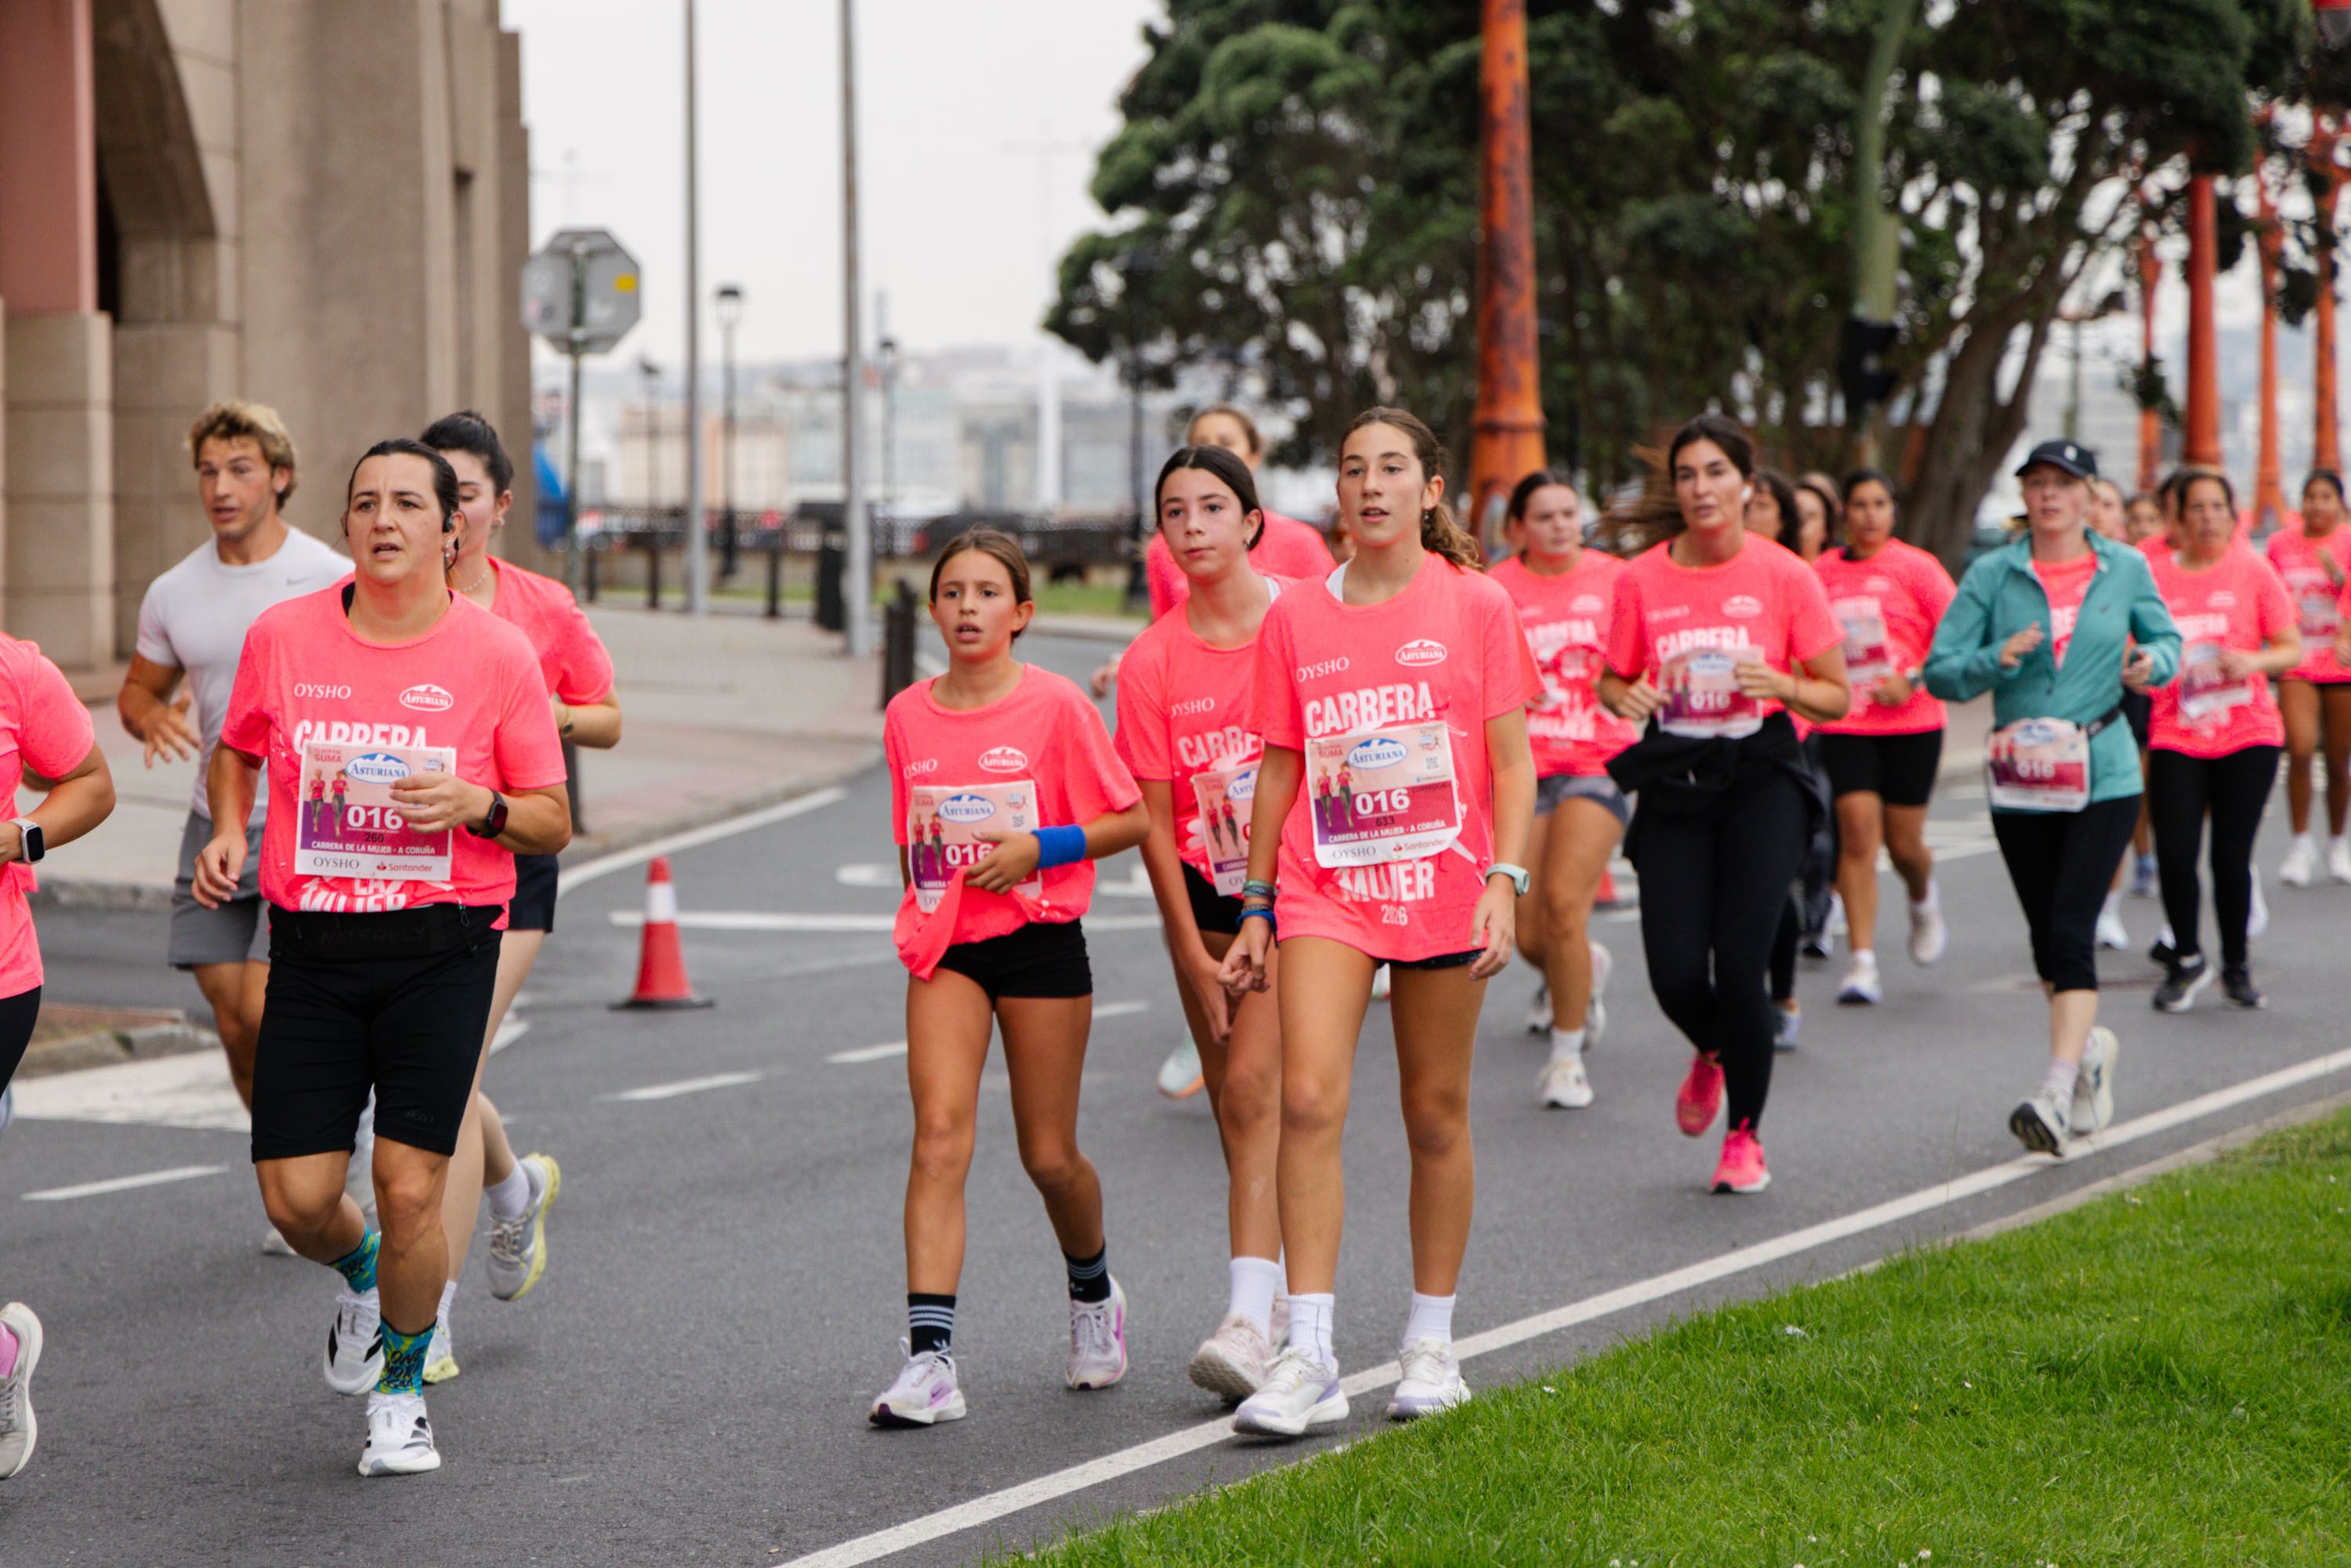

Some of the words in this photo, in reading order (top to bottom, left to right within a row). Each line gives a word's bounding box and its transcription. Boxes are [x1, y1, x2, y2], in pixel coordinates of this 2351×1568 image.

[1400, 650, 1444, 661] ASTURIANA
[1296, 657, 1349, 683] OYSHO
[294, 683, 352, 700] OYSHO
[404, 693, 448, 706] ASTURIANA
[1305, 681, 1436, 737] CARRERA
[314, 754, 342, 763] SUMA
[983, 756, 1023, 767] ASTURIANA
[1353, 750, 1404, 764] ASTURIANA
[350, 762, 406, 777] ASTURIANA
[1356, 788, 1410, 816] 016
[347, 806, 403, 830] 016
[943, 806, 991, 816] ASTURIANA
[1375, 816, 1395, 827] 633
[364, 832, 384, 843] 260
[1328, 832, 1359, 843] CARRERA
[1360, 830, 1369, 839] DE
[1370, 829, 1379, 838] LA
[1380, 827, 1405, 837] MUJER
[1417, 820, 1446, 831] CORUÑA
[311, 841, 344, 851] CARRERA
[356, 843, 366, 852] LA
[368, 844, 392, 853] MUJER
[405, 846, 435, 855] CORUÑA
[1404, 838, 1446, 851] Santander
[1332, 846, 1376, 860] OYSHO
[313, 856, 360, 870] OYSHO
[388, 863, 433, 872] Santander
[1340, 860, 1435, 902] MUJER
